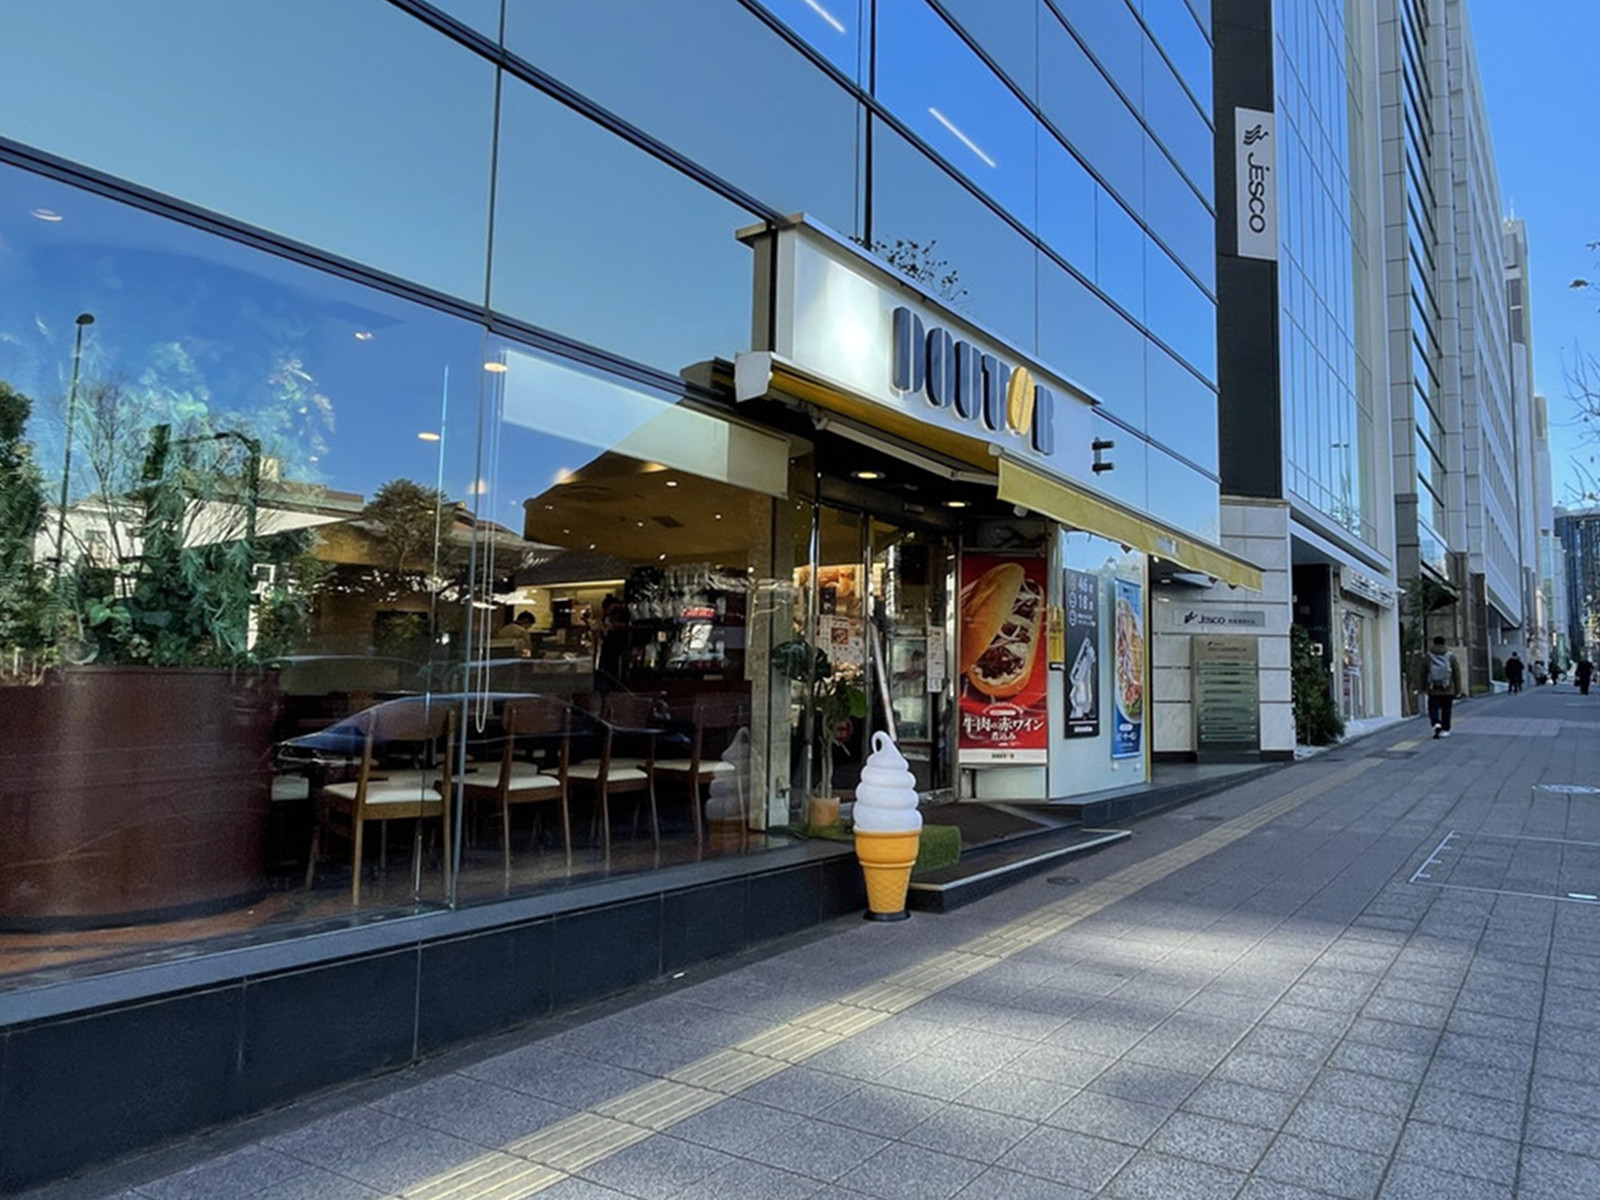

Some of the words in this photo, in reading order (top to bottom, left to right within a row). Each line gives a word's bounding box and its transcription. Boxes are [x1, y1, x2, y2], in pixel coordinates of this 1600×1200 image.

[891, 306, 1055, 456] DOUTOR
[962, 716, 1045, 732] 牛肉の赤ワイン
